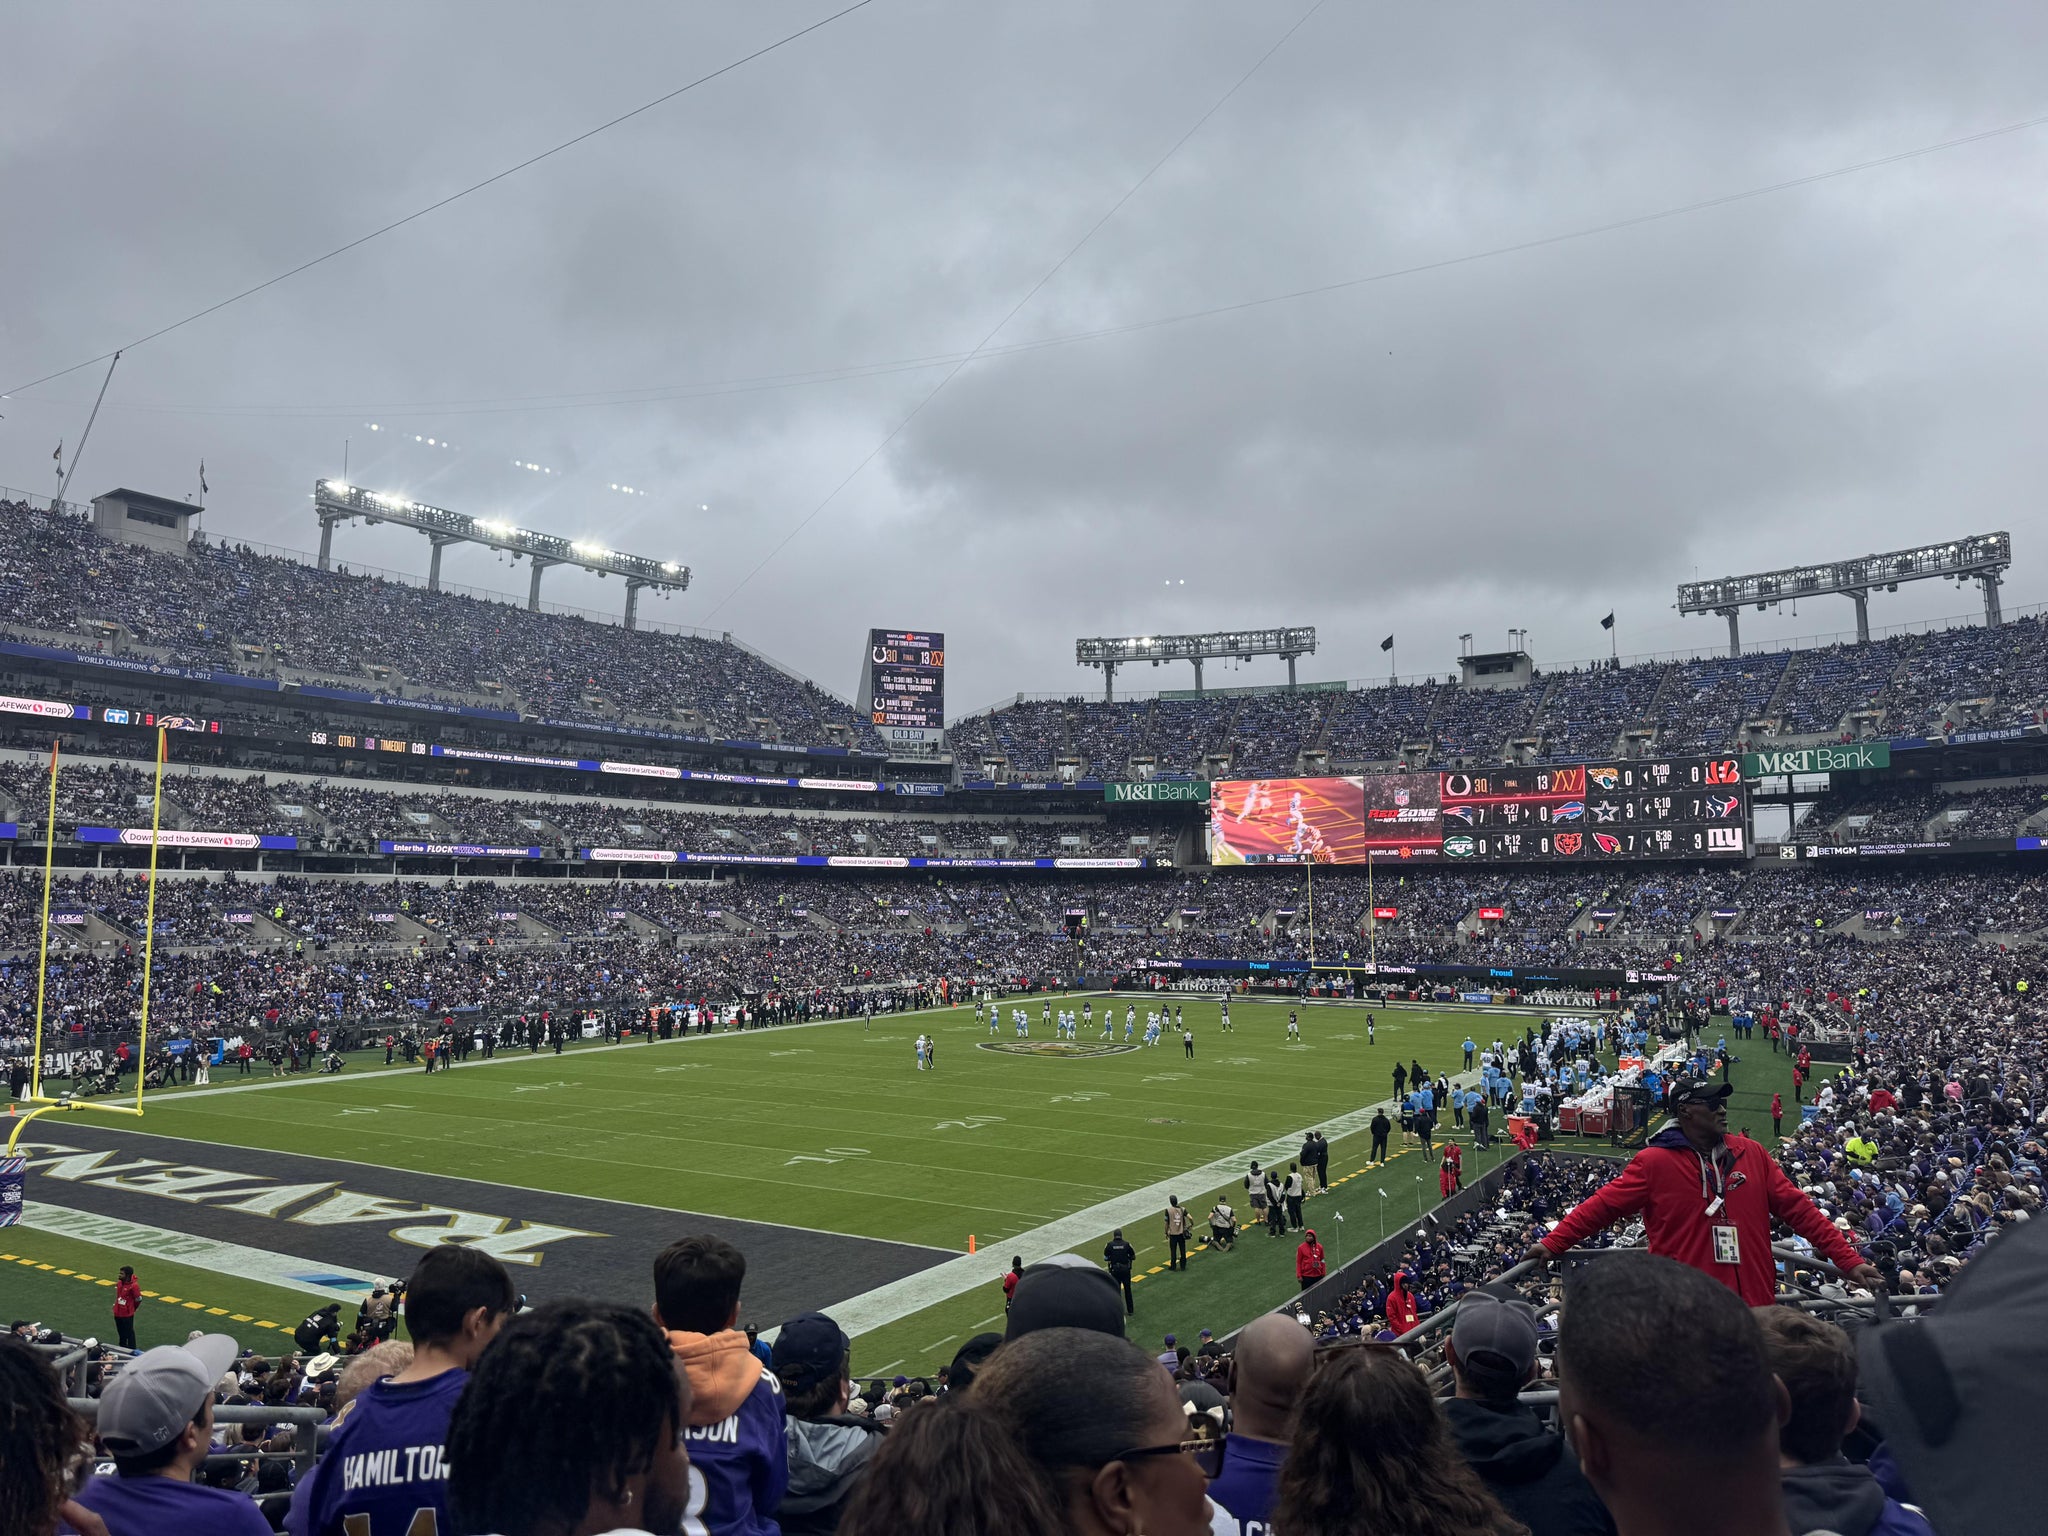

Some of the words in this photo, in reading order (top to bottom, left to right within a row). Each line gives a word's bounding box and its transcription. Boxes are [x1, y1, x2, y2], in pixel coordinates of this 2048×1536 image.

[886, 649, 898, 662] 30
[920, 651, 930, 665] 13
[77, 655, 104, 666] WORLD
[106, 660, 148, 671] CHAMPIONS
[163, 667, 180, 676] 2000
[195, 671, 212, 680] 2012
[45, 706, 67, 716] app!
[398, 700, 429, 710] CHAMPIONS
[430, 703, 444, 711] 2000
[447, 705, 461, 713] 2012
[135, 712, 141, 725] 7
[201, 719, 207, 732] 7
[559, 720, 574, 728] NORTH
[575, 722, 601, 731] CHAMPIONS
[311, 732, 327, 745] 5:56
[338, 735, 351, 748] QTR
[894, 731, 908, 739] OLD
[909, 731, 923, 740] BAY
[1978, 733, 1989, 741] HELP
[380, 739, 407, 753] TIMEOUT
[411, 743, 426, 755] 0:08
[443, 748, 455, 756] Win
[456, 750, 485, 760] groceries
[499, 754, 514, 763] year,
[535, 757, 554, 765] tickets
[1756, 750, 1815, 774] M&T
[1817, 746, 1875, 770] Bank
[1625, 770, 1632, 786] 0
[1652, 763, 1670, 776] 0:00
[1656, 775, 1667, 786] 1ST
[915, 783, 938, 793] merritt
[1474, 778, 1488, 793] 30
[1504, 779, 1518, 788] FINAL
[1537, 774, 1548, 790] 13
[1114, 784, 1157, 800] M&T
[1158, 783, 1199, 800] Bank
[1479, 807, 1485, 823] 7
[1503, 803, 1519, 815] 3:27
[1540, 806, 1547, 822] 0
[1626, 803, 1634, 818] 3
[1654, 797, 1671, 809] 5:10
[1693, 800, 1700, 816] 7
[1657, 808, 1669, 819] 1ST
[1508, 814, 1518, 824] 1ST
[129, 833, 174, 843] Downoad
[176, 833, 190, 843] the
[191, 835, 224, 845] SAFEWAY
[235, 837, 254, 846] app!
[1479, 839, 1487, 854] 0
[1504, 835, 1520, 846] 9:12
[1628, 836, 1634, 851] 7
[1655, 830, 1672, 842] 6:36
[1694, 833, 1702, 849] 3
[393, 844, 411, 852] Enter
[427, 845, 453, 854] FLOCK
[487, 847, 529, 857] sweepstakes!
[1508, 845, 1518, 855] 1ST
[1659, 841, 1670, 853] 1ST
[1782, 846, 1795, 858] 25
[1819, 847, 1858, 855] BETMGM
[1249, 962, 1270, 970] Proud
[1400, 966, 1416, 974] Price
[1490, 969, 1513, 977] Proud
[1667, 973, 1680, 981] Pric
[1049, 1091, 1111, 1103] 30
[931, 1115, 1007, 1131] 20
[783, 1147, 873, 1166] 10
[343, 1444, 451, 1491] HAMILTON
